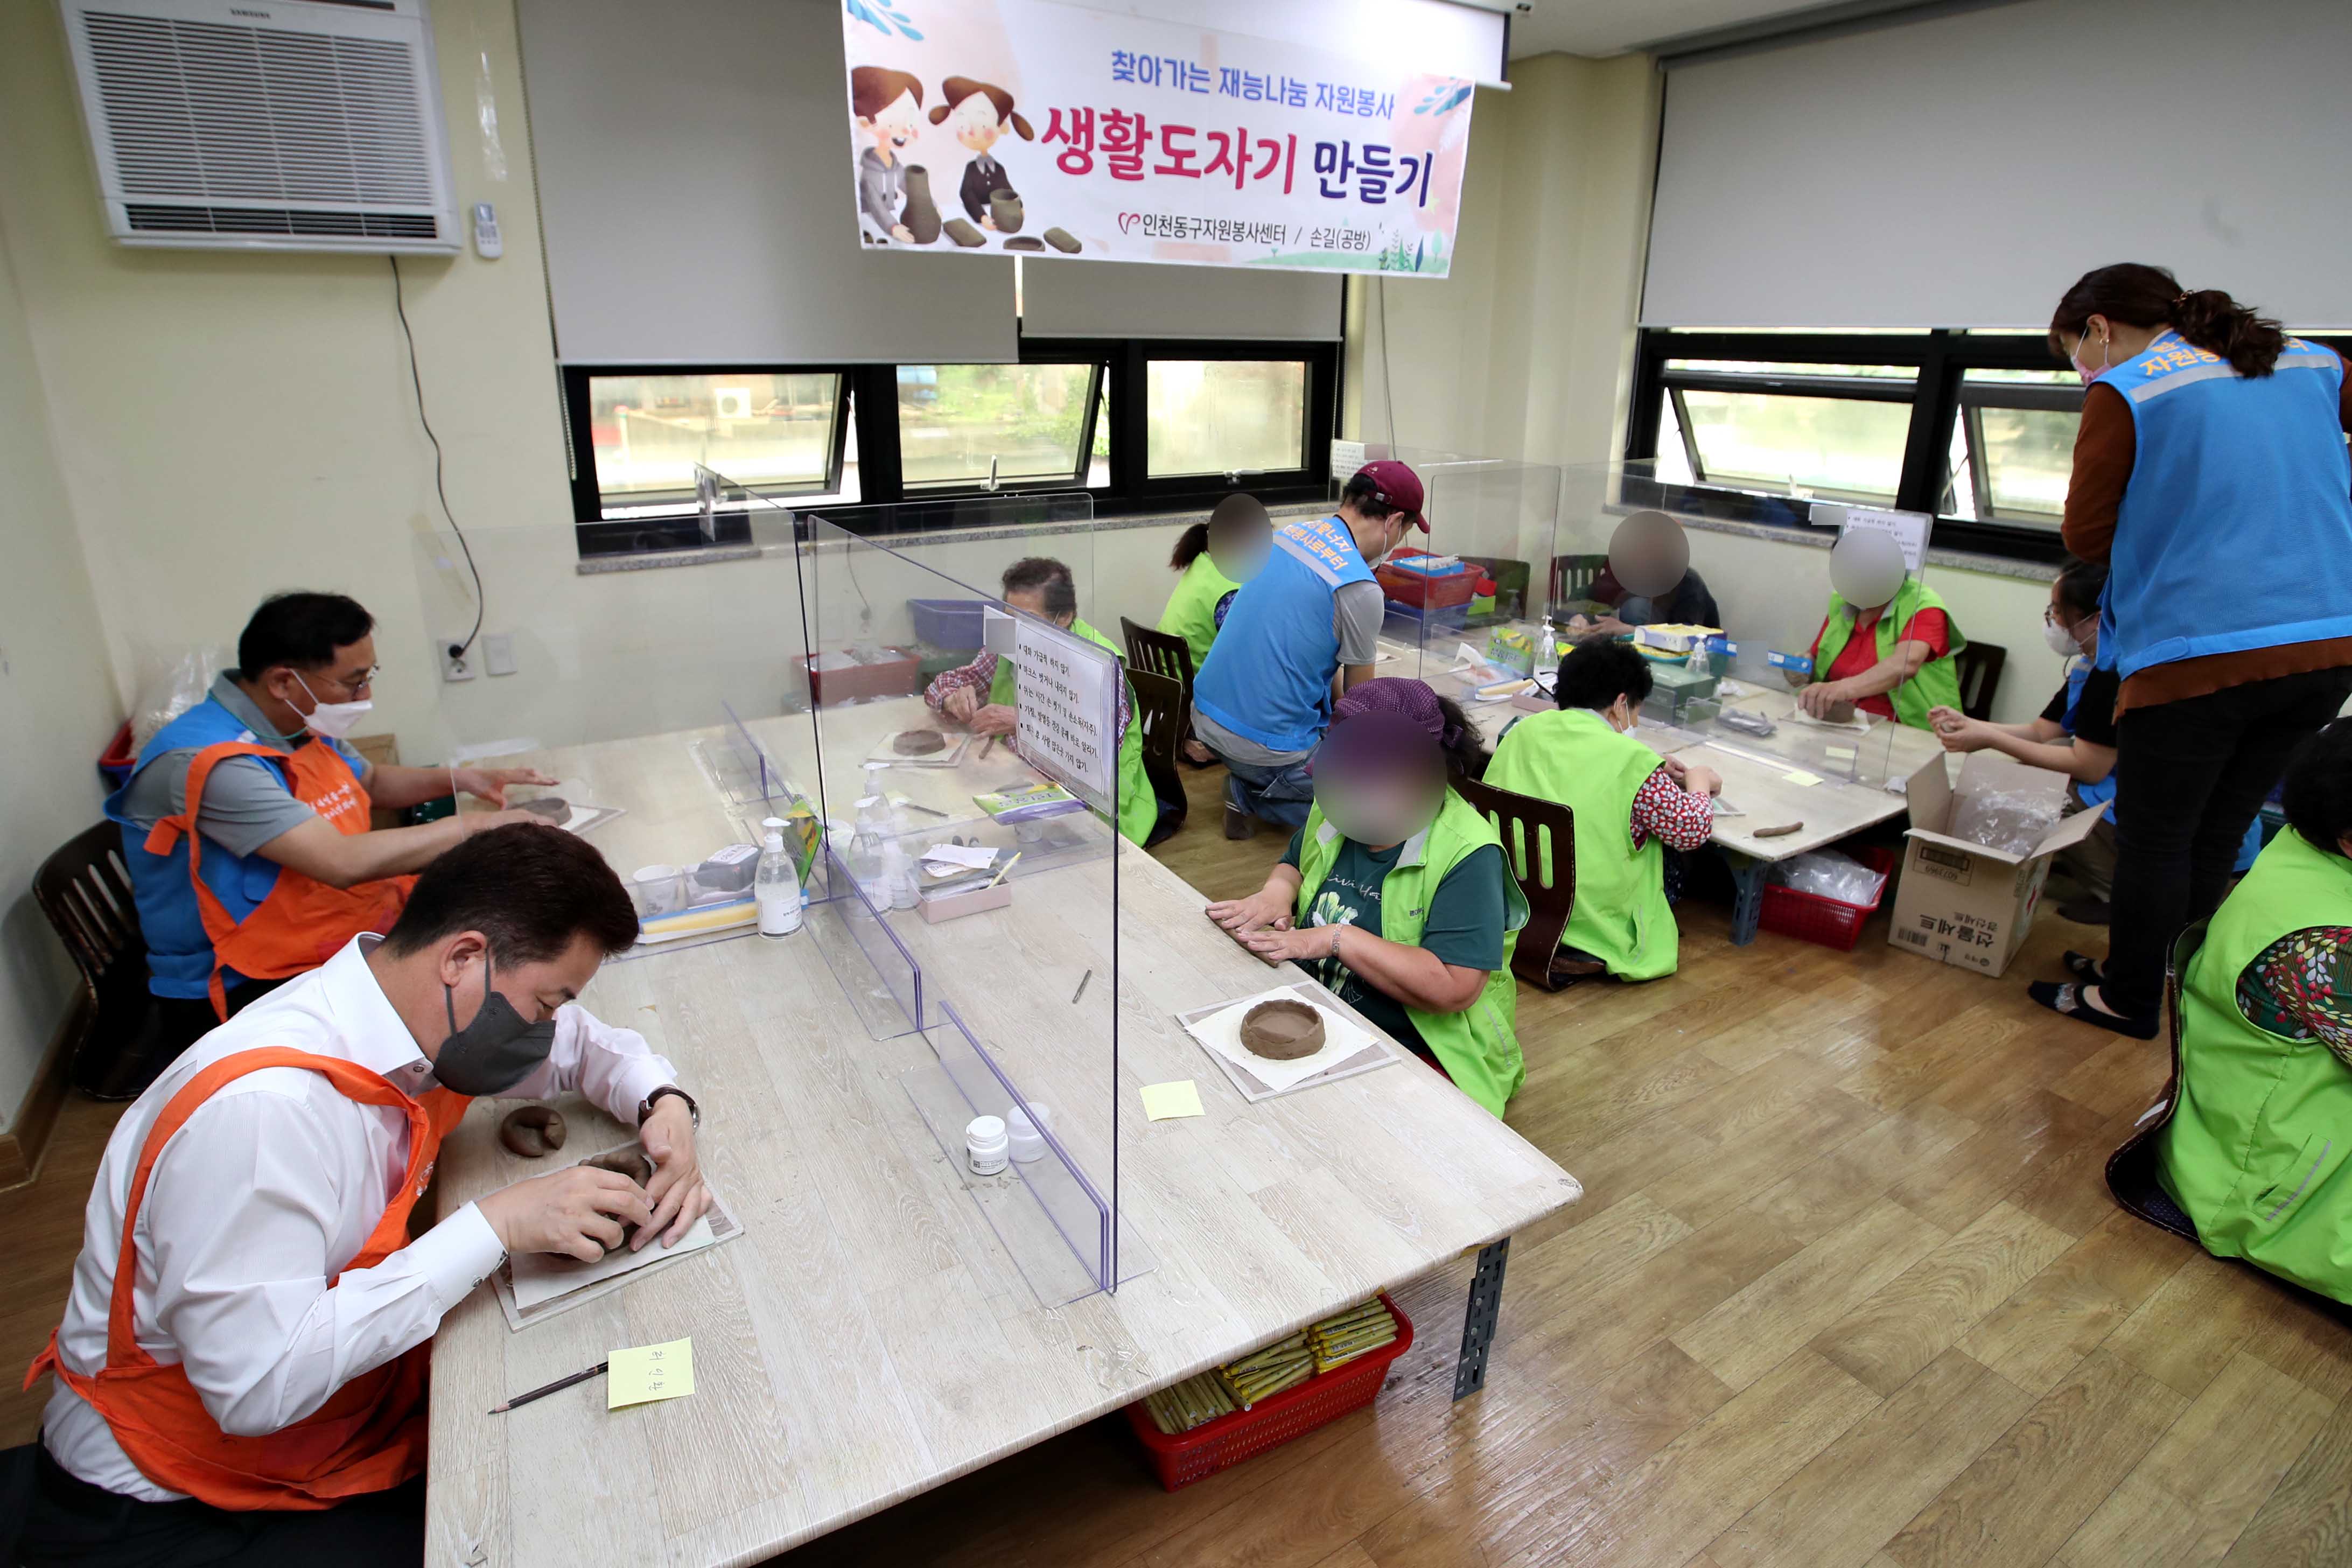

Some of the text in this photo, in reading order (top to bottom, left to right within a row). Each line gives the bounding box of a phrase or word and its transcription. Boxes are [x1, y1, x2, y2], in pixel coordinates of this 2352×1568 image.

[1111, 50, 1395, 120] 찾아가는 재능나눔 자원봉사
[1041, 107, 1433, 208] 생활도자기 만들기
[1142, 213, 1286, 246] 인천동구자원봉사센터
[1310, 227, 1371, 251] 손길(공방)
[1033, 650, 1048, 666] 가급적
[1049, 657, 1059, 671] 하지
[1023, 685, 1034, 698] 쉬는
[1035, 691, 1045, 704] 시간
[1046, 697, 1052, 708] 손
[1038, 673, 1053, 688] 벗거나
[1035, 730, 1040, 740] 후
[1041, 734, 1051, 748] 사람
[1065, 751, 1075, 766] 가지
[1070, 733, 1080, 748] 바로
[1920, 914, 1994, 948] 선물세트
